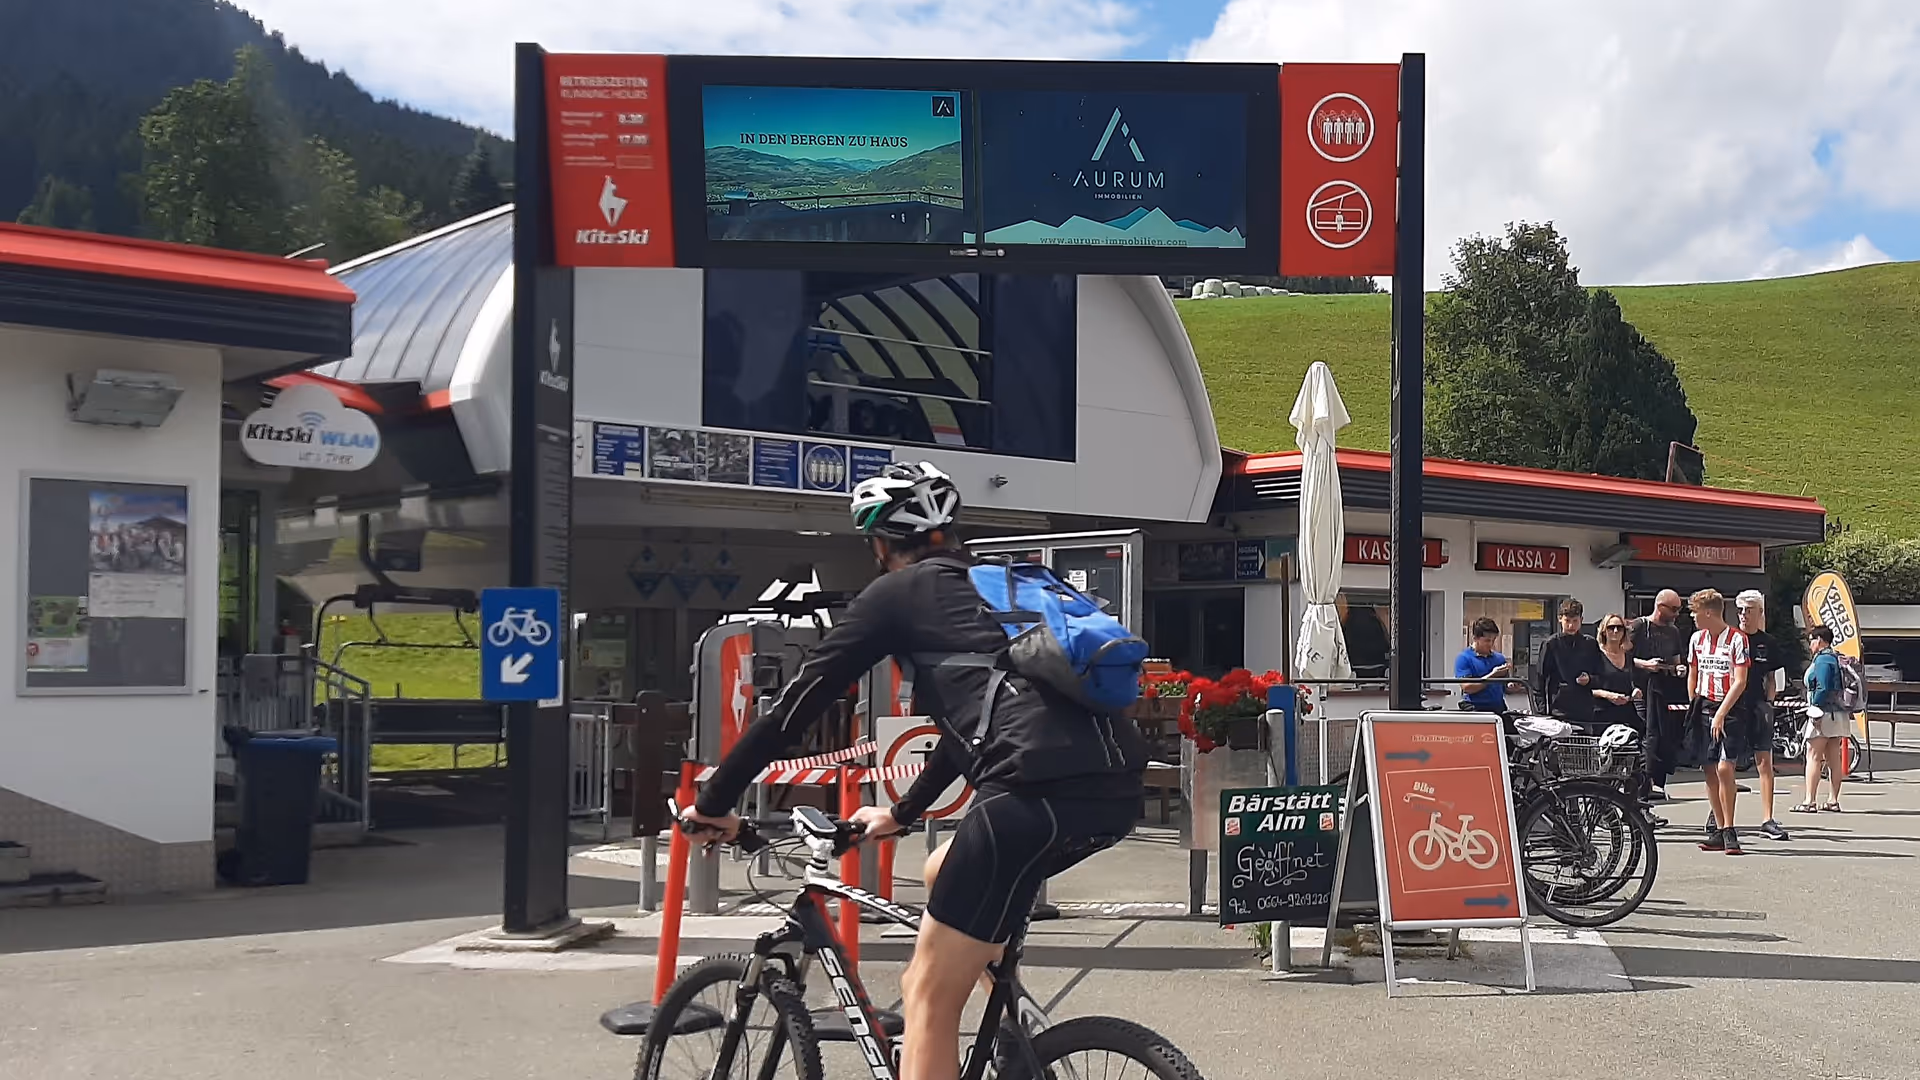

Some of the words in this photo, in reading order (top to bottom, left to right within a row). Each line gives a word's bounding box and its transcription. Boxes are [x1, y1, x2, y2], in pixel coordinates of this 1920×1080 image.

[740, 133, 755, 144] IN
[759, 133, 787, 145] DEN
[790, 134, 845, 146] BERGEN
[848, 135, 867, 147] ZU
[869, 136, 909, 148] HAUS
[1073, 170, 1165, 189] AURUM
[576, 229, 649, 245] KitzSki
[1039, 235, 1188, 247] www.aurum-immobilien.com
[247, 423, 313, 444] KitzSki
[321, 430, 376, 449] WLAN
[1358, 539, 1392, 561] KAS
[1496, 549, 1543, 569] KASSA
[1549, 552, 1557, 570] 2
[1413, 781, 1435, 794] Bike
[1228, 791, 1332, 813] Bärstätt
[1257, 813, 1306, 832] Alm
[1234, 841, 1330, 884] Geöffnet
